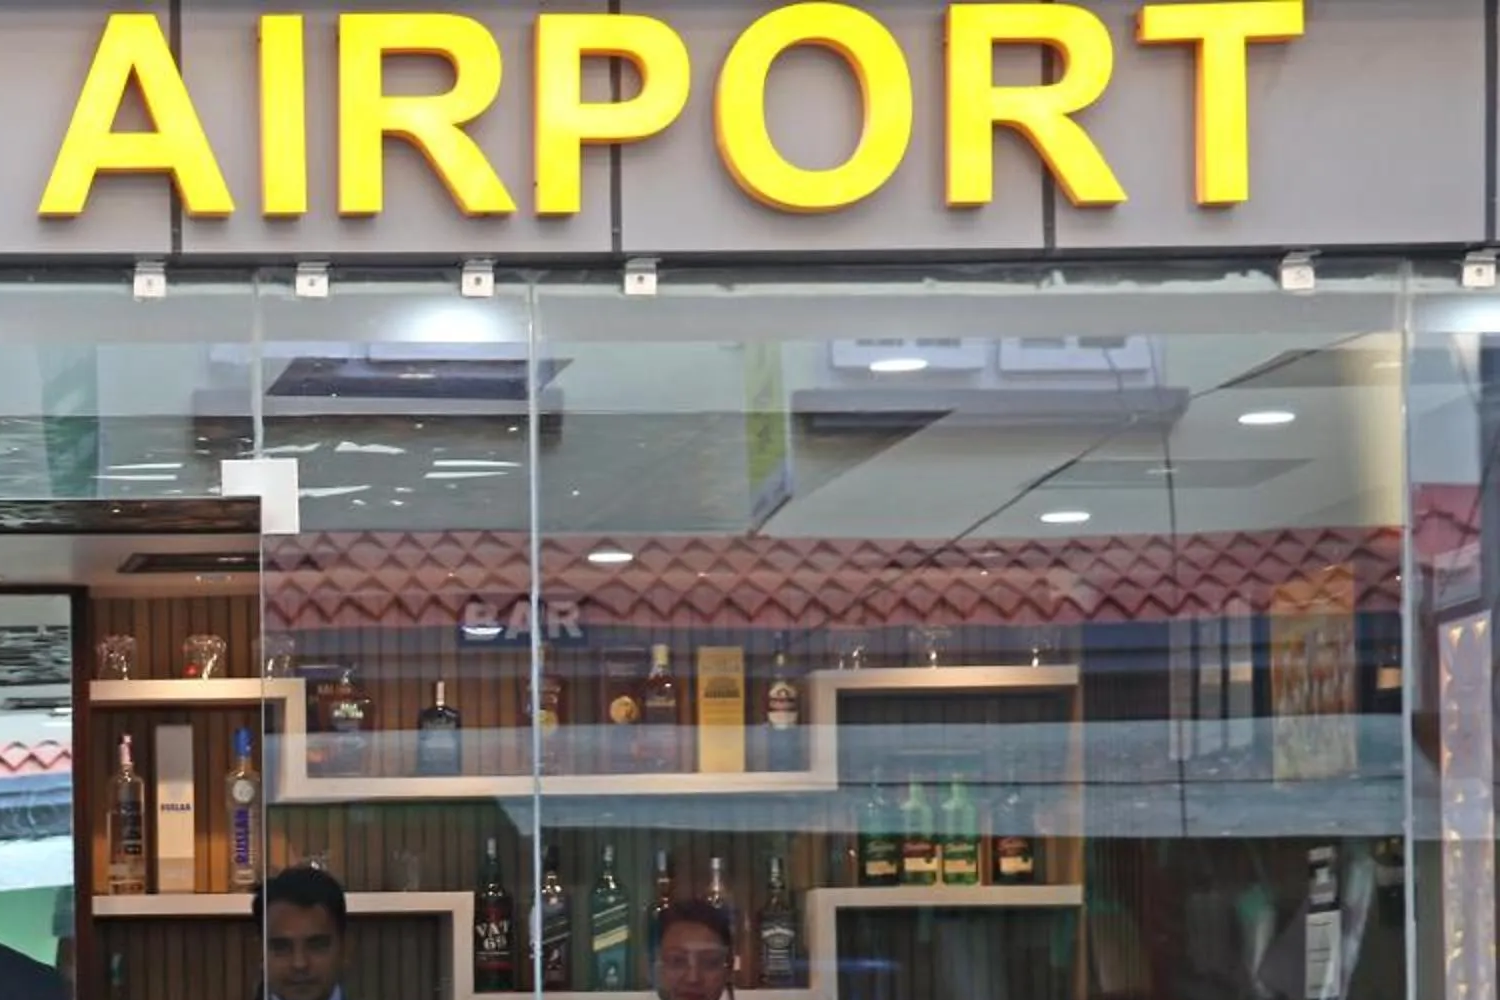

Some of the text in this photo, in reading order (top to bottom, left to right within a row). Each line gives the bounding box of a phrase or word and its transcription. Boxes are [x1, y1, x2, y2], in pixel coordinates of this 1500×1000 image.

[38, 0, 1305, 217] AIRPORT
[464, 601, 583, 640] BAR
[476, 920, 510, 937] VAT
